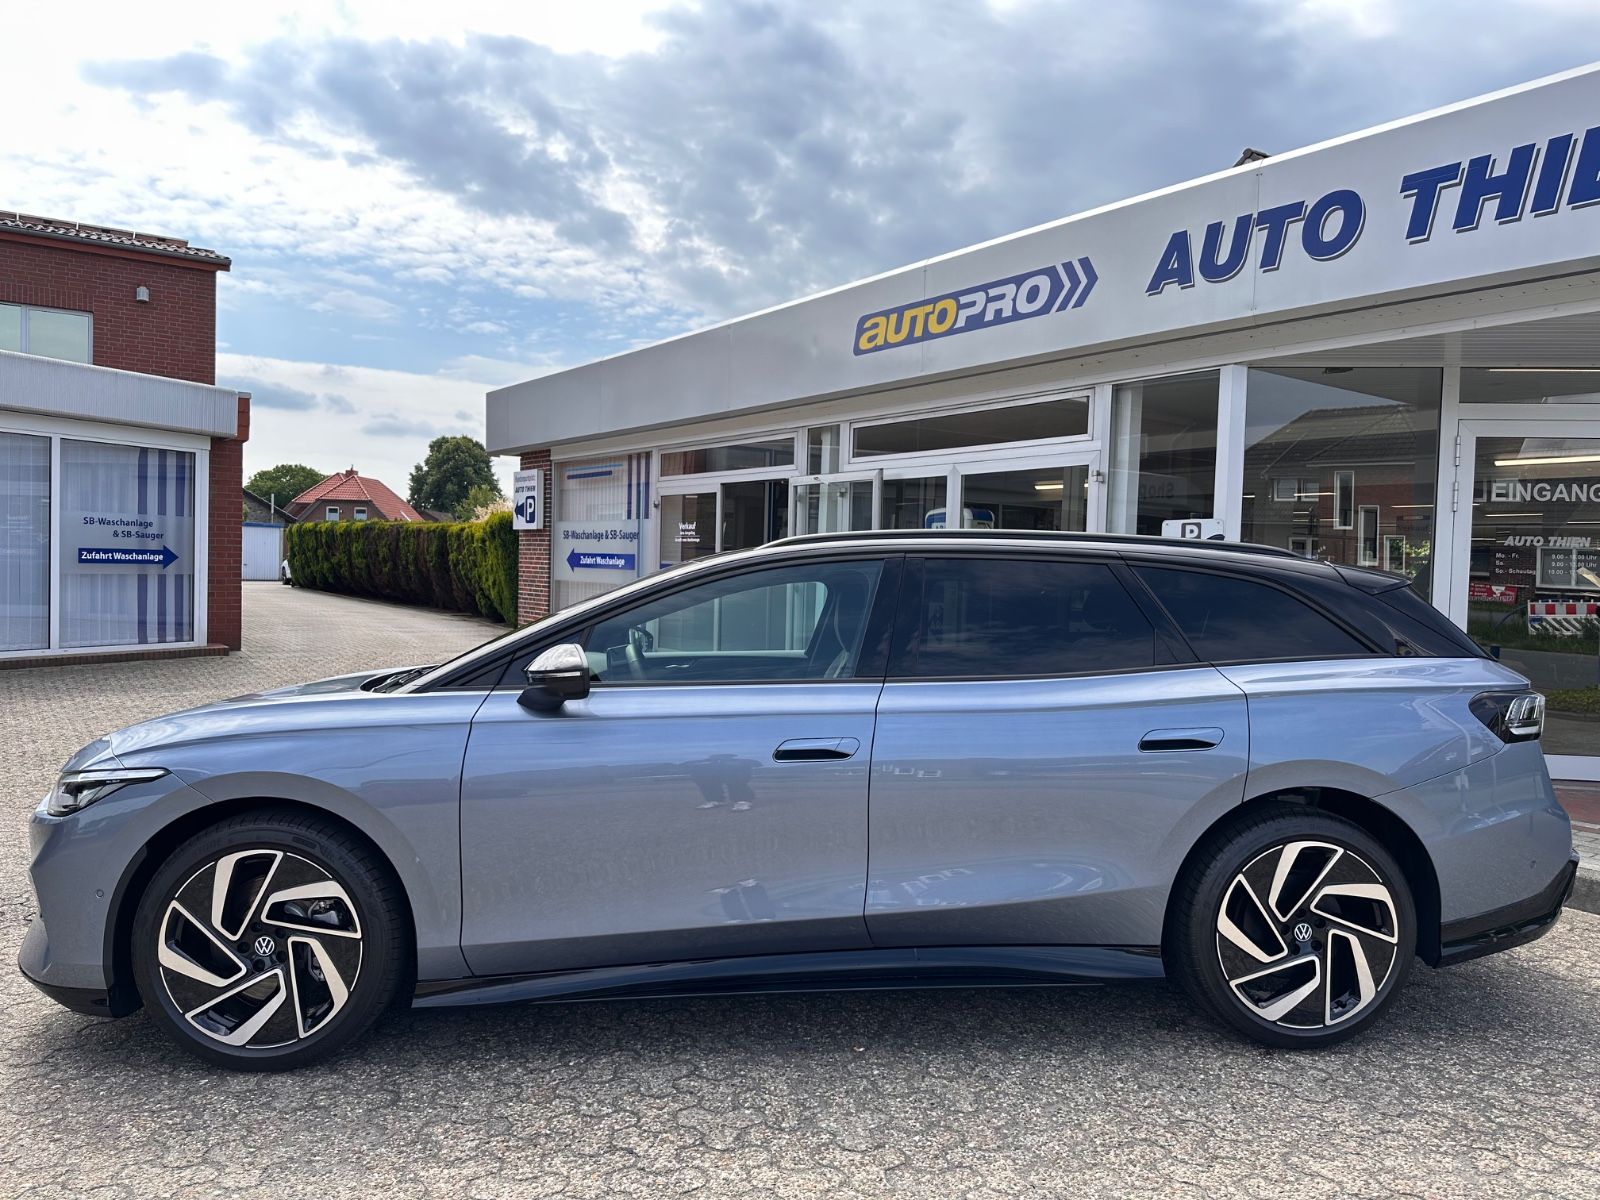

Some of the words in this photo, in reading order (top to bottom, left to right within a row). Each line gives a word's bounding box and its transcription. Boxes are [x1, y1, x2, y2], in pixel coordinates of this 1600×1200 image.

[1146, 189, 1365, 296] AUTO
[526, 498, 535, 520] P
[83, 516, 154, 529] SB-Waschanlage
[112, 529, 120, 538] &
[121, 530, 164, 541] SB-Sauger
[563, 529, 604, 542] SB-Waschanlage
[604, 529, 610, 540] &
[610, 529, 639, 542] SB-Sauger
[1503, 535, 1544, 547] AUTO
[1548, 536, 1591, 548] THIEN
[81, 551, 113, 560] Zufahrt
[113, 551, 164, 562] Waschanlage
[579, 555, 596, 565] Zufahrt
[596, 555, 625, 568] Waschanlage
